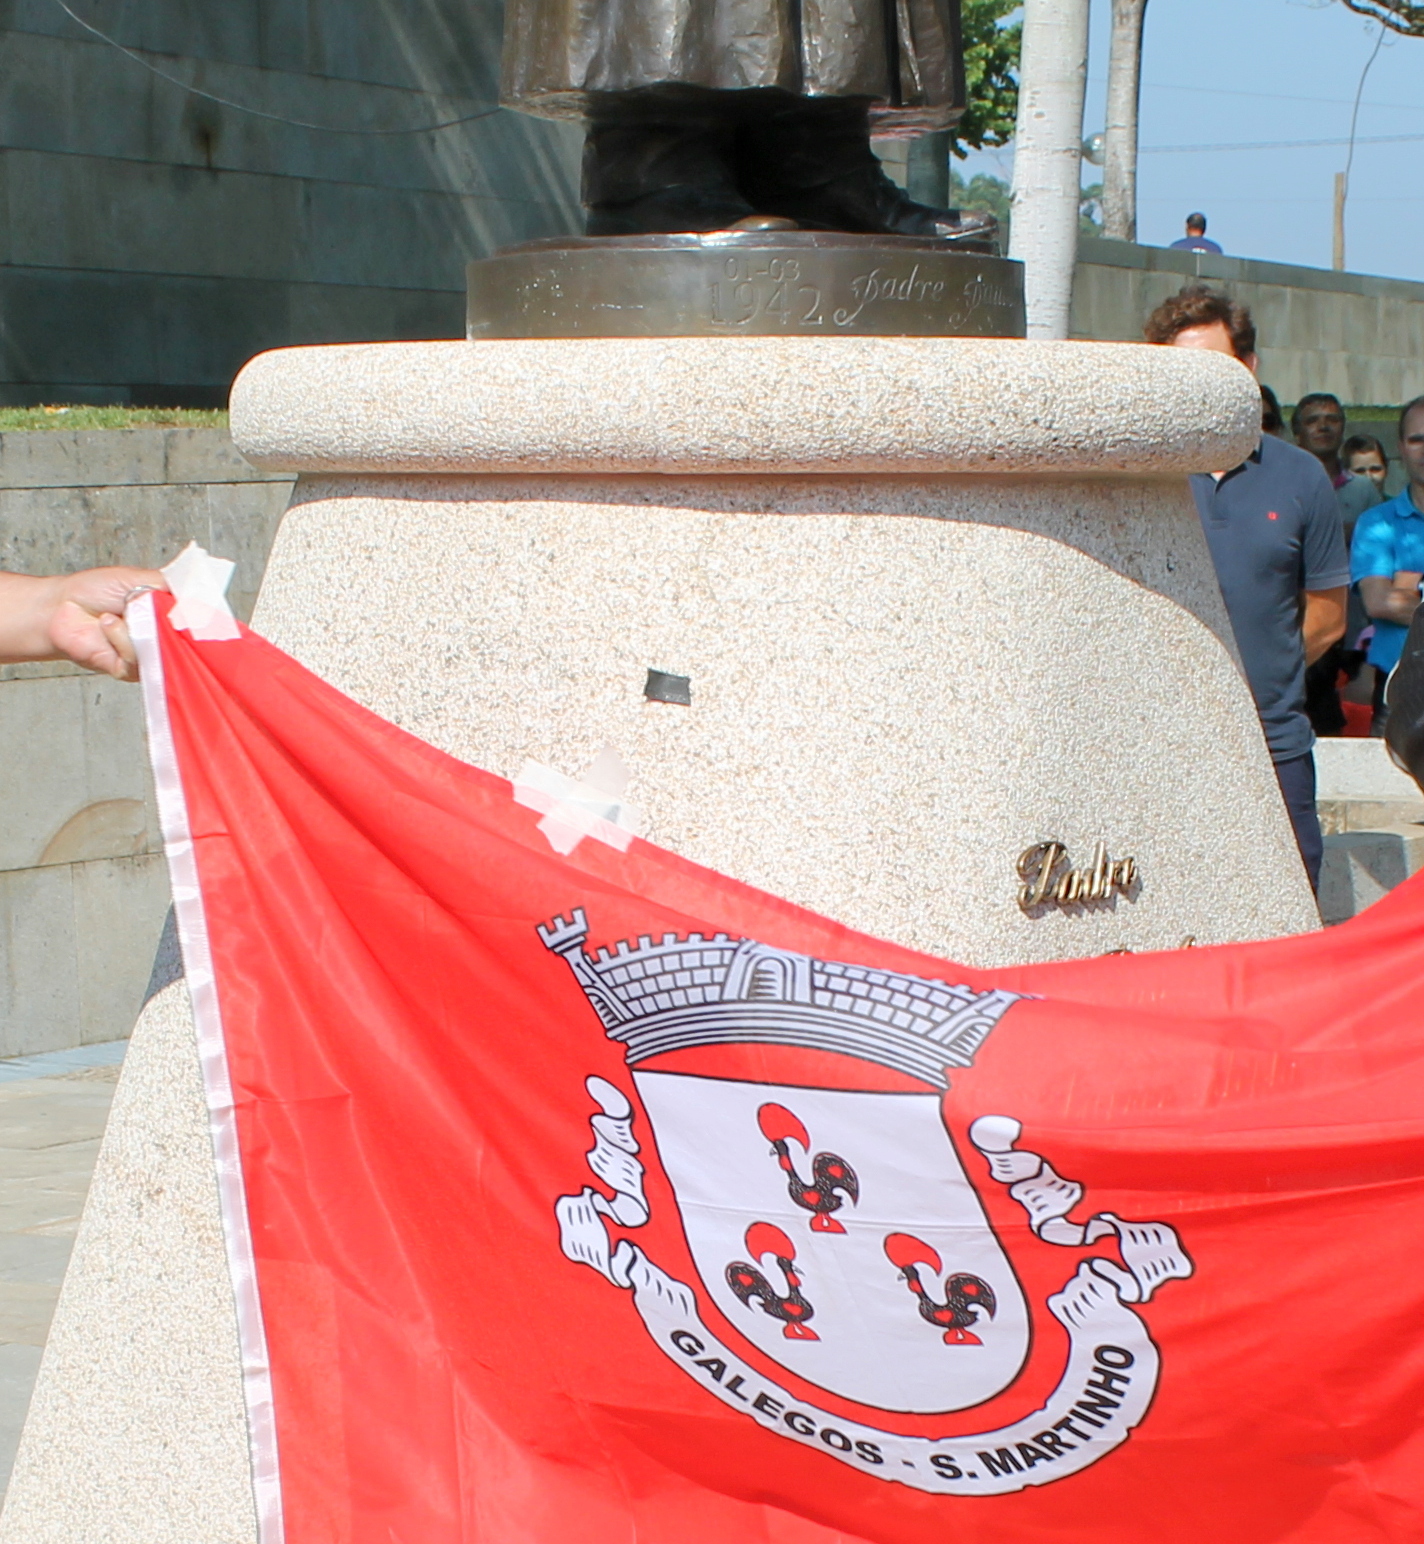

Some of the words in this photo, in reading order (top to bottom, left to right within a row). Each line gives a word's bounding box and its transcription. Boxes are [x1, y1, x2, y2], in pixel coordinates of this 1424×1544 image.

[710, 282, 823, 325] 1942
[833, 264, 945, 326] Padre
[670, 1330, 884, 1464] GALEGOS
[929, 1454, 979, 1479] S.
[976, 1344, 1135, 1477] MARTINHO
